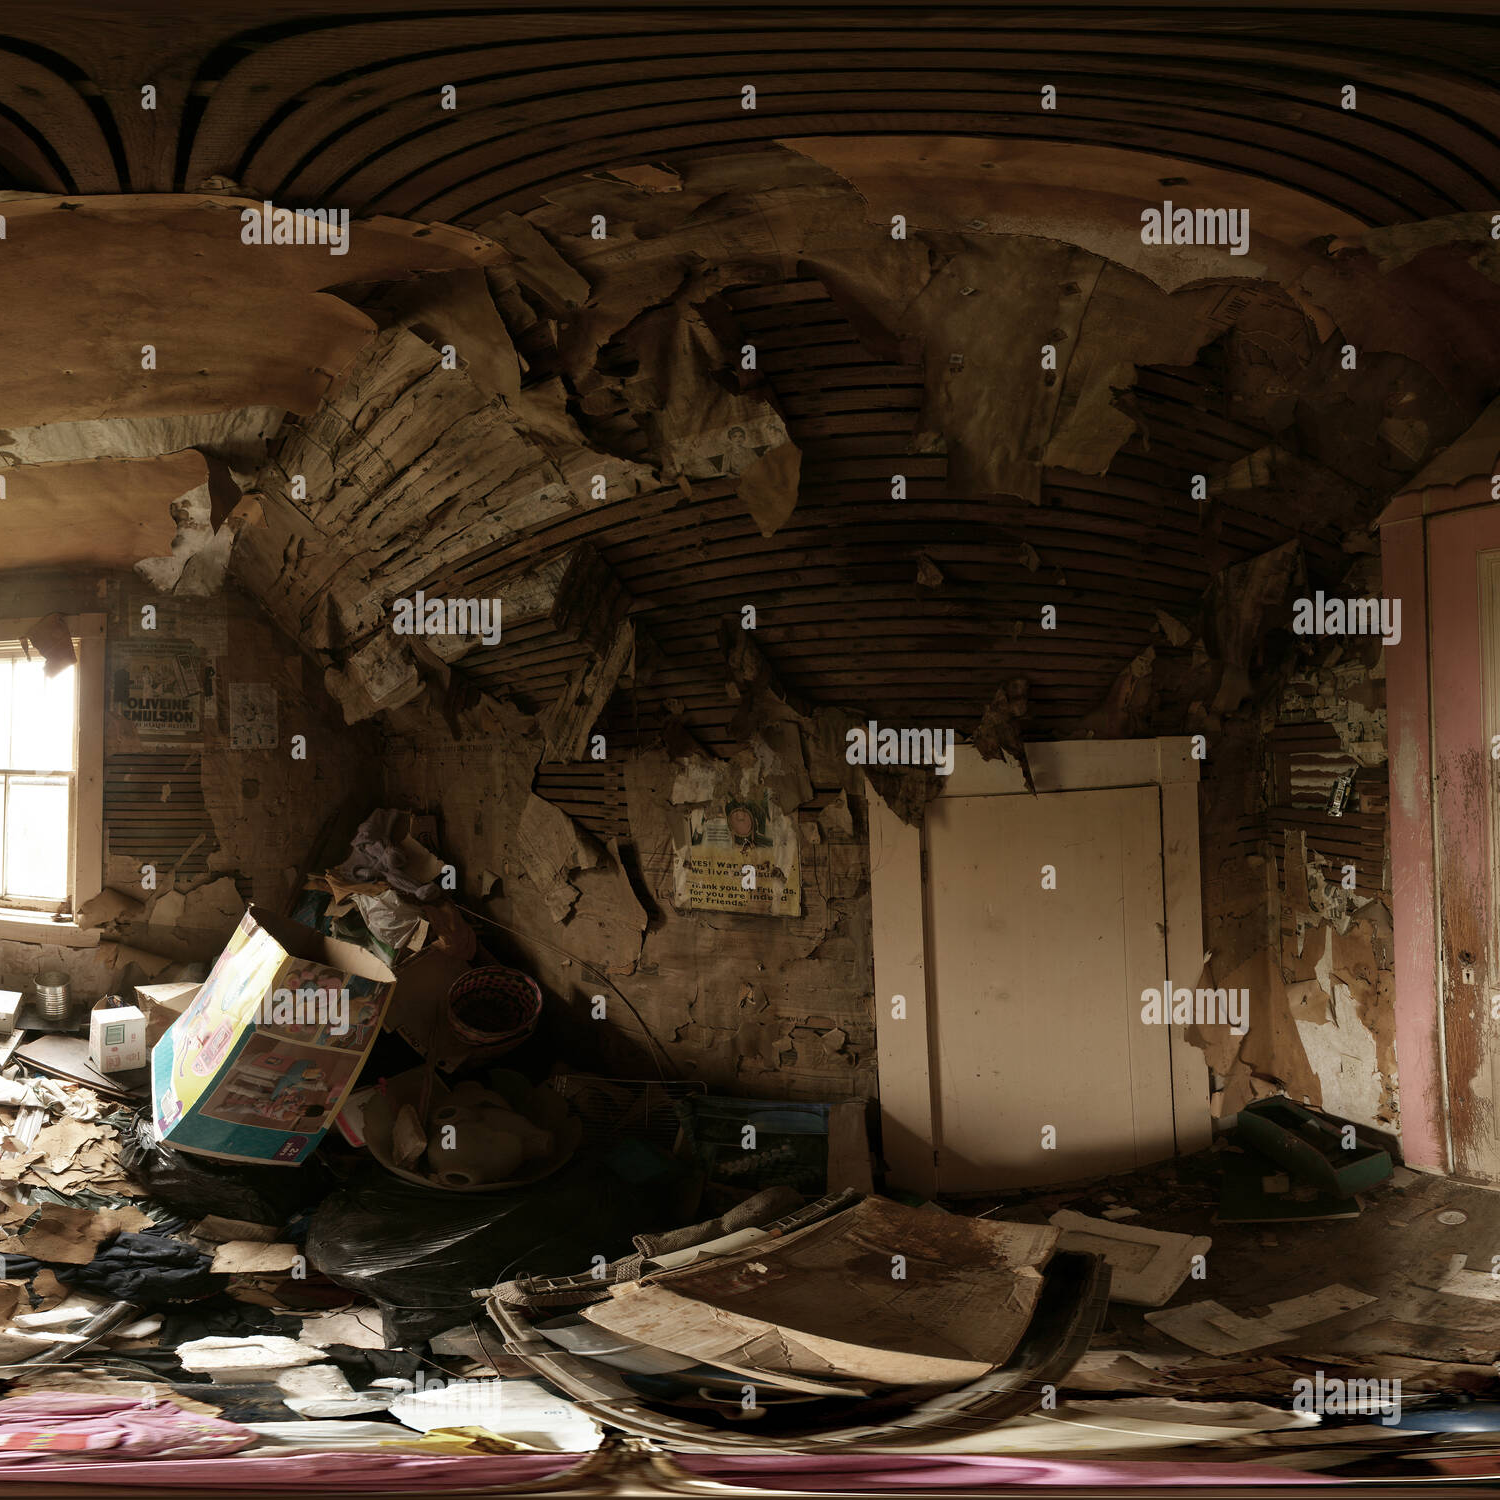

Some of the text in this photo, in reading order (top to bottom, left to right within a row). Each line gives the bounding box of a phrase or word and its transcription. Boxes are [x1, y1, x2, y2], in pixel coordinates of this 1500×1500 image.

[124, 711, 194, 723] EMULSION
[716, 861, 738, 869] War
[691, 867, 704, 875] We
[708, 868, 729, 876] live
